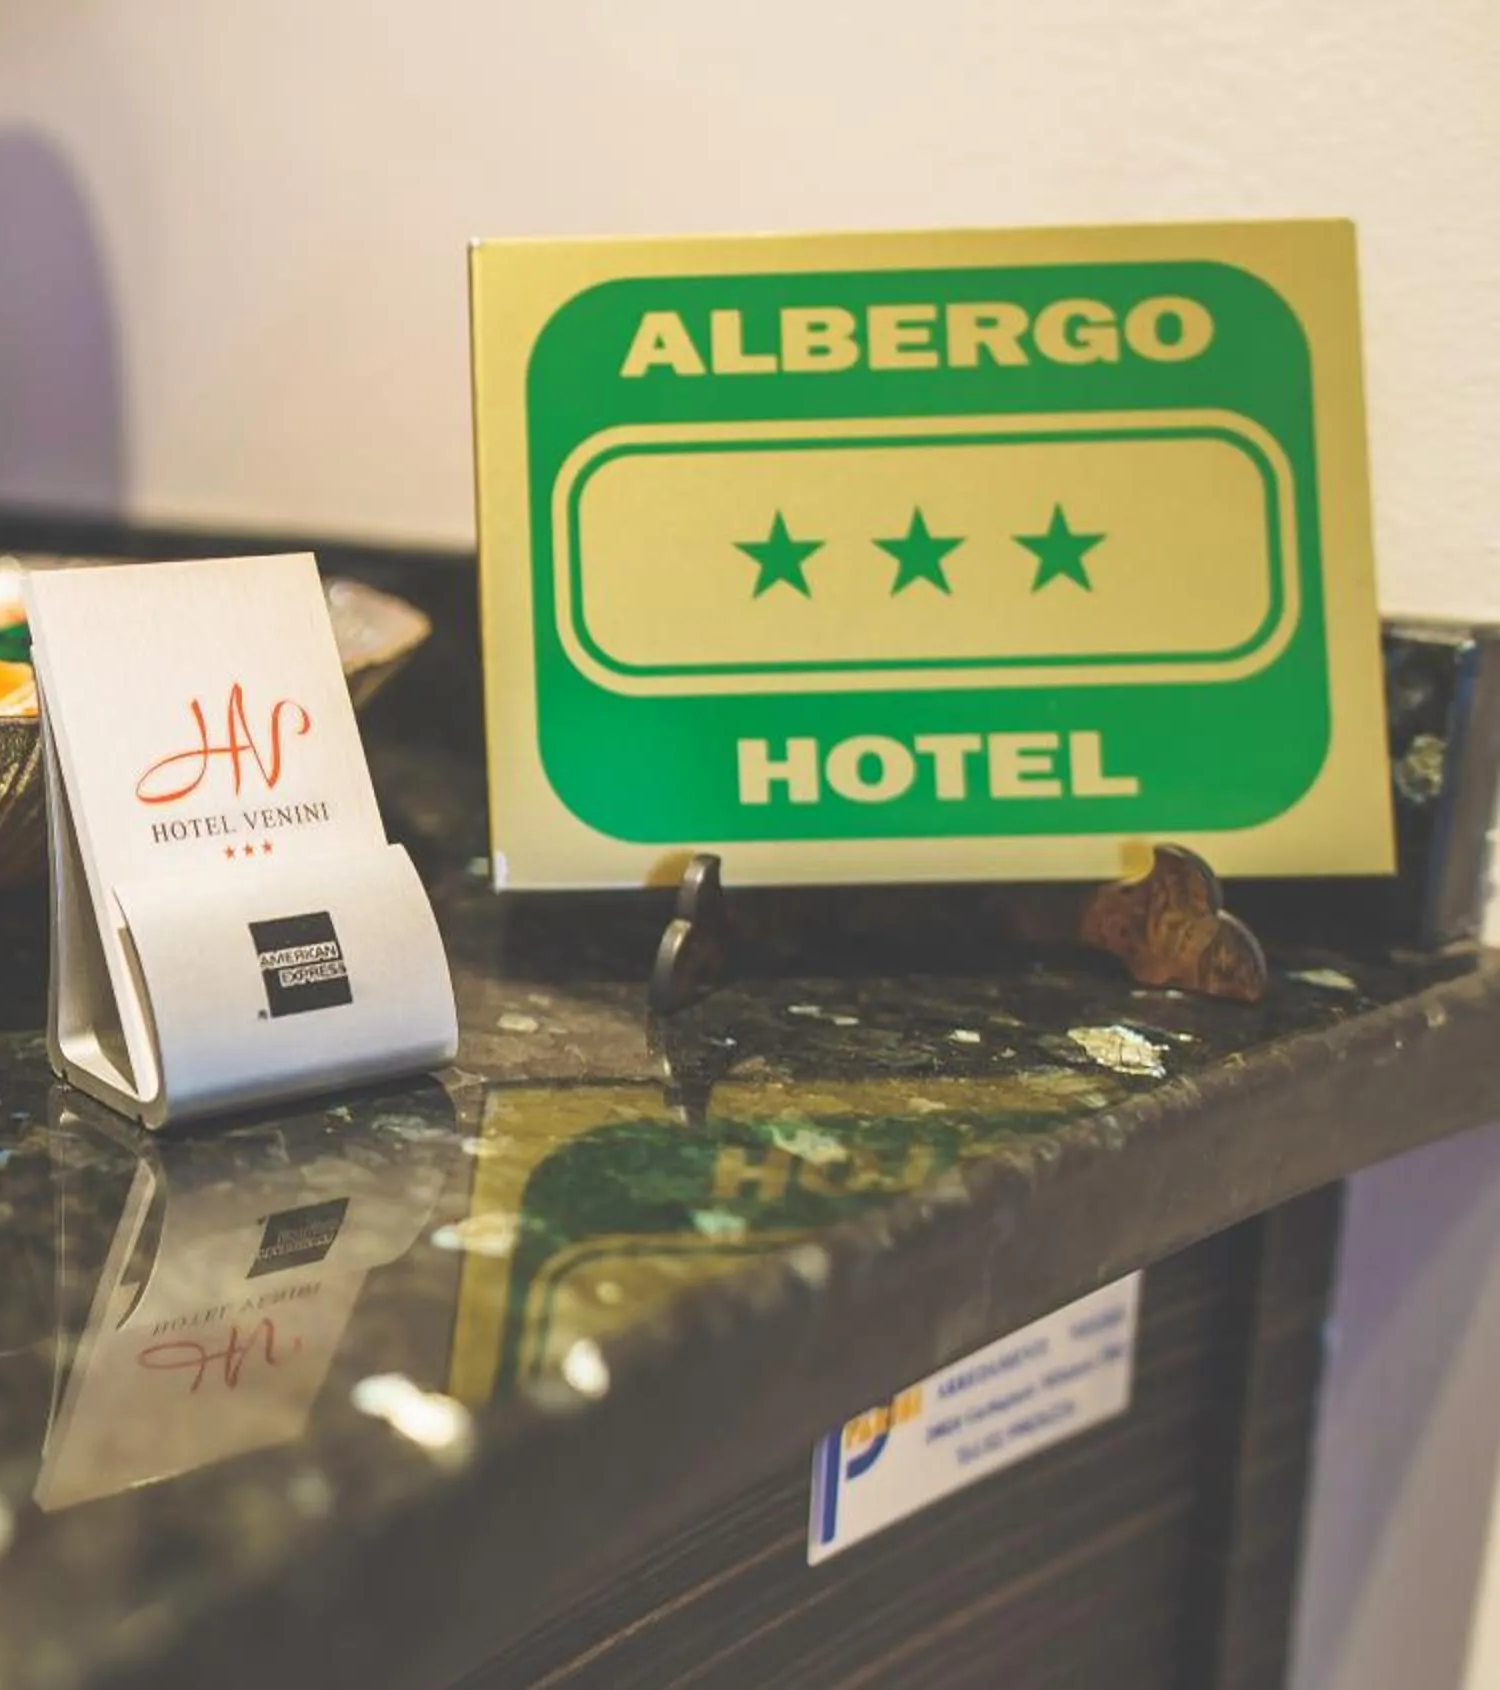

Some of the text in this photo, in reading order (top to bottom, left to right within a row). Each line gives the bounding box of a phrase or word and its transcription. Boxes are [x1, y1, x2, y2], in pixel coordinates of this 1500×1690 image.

[621, 297, 1214, 377] ALBERGO
[737, 731, 1140, 804] HOTEL
[151, 801, 330, 843] HOTEL VENINI
[259, 943, 338, 966] AMERICAN
[279, 961, 347, 985] EXPRESS
